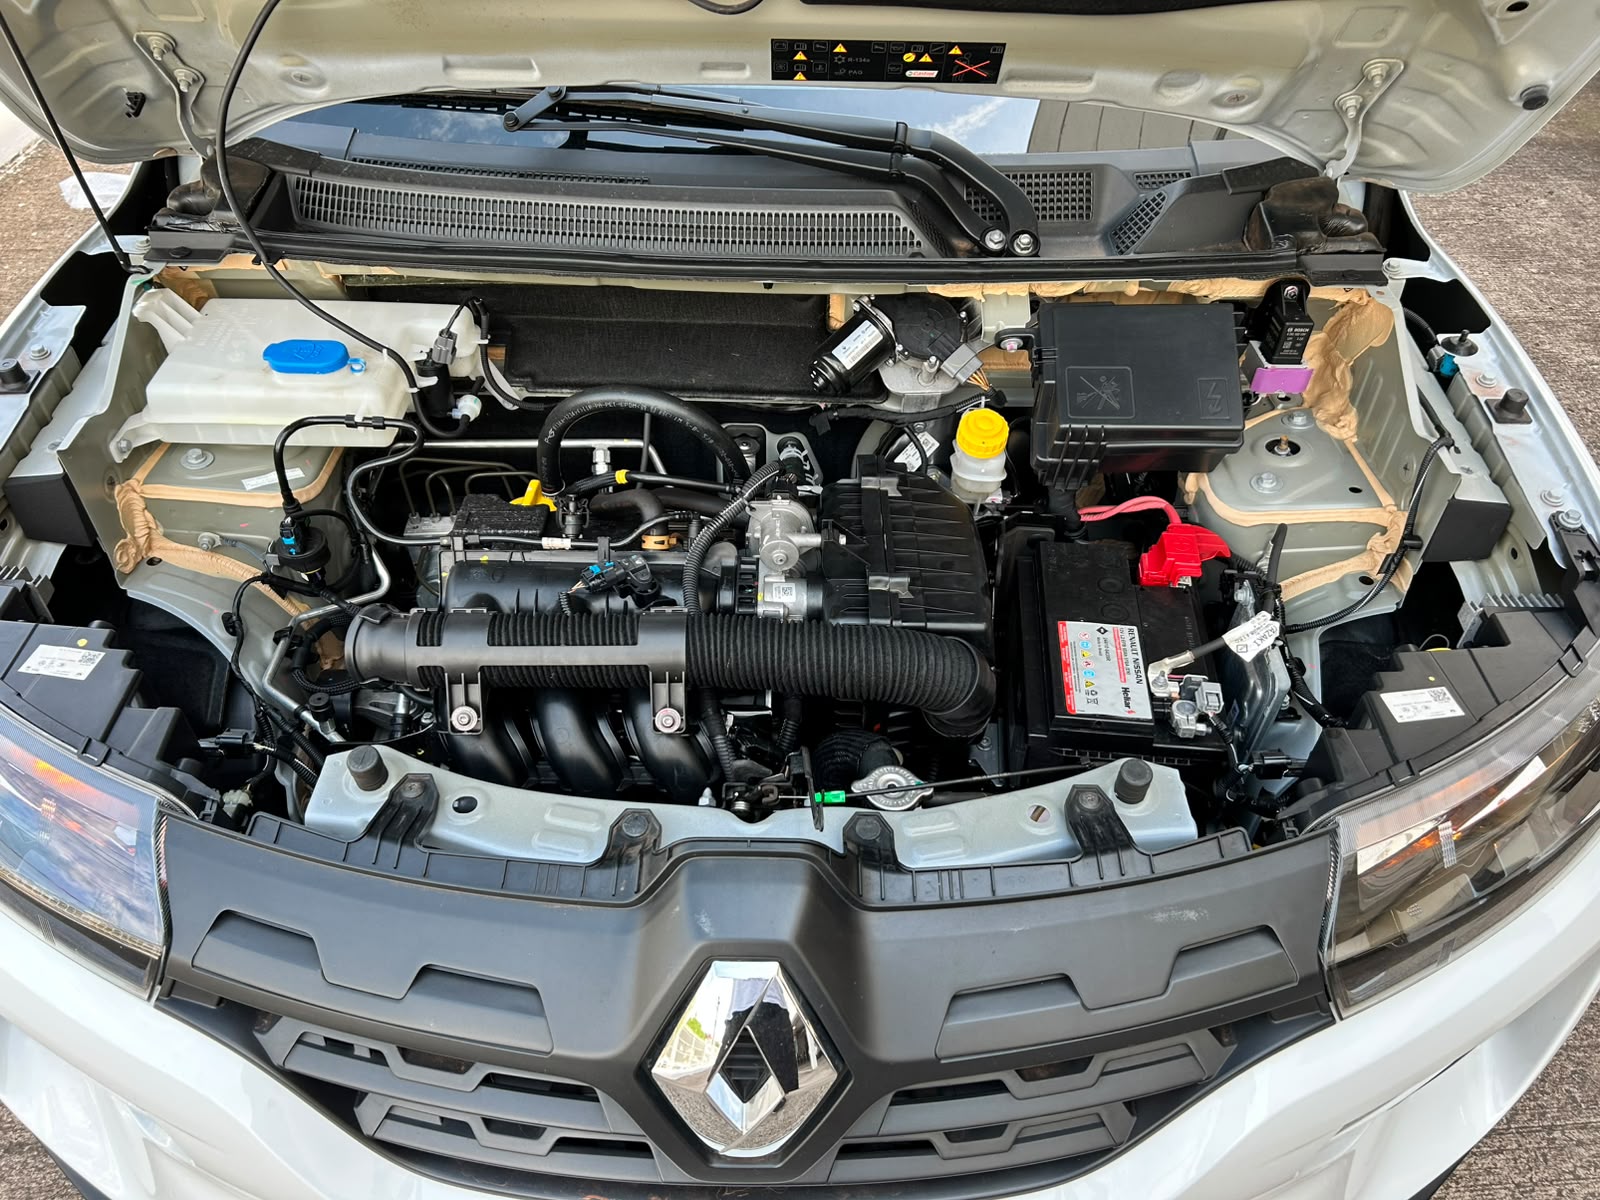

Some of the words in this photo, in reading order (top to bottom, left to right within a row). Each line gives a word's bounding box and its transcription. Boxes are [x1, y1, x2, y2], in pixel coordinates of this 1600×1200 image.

[1127, 628, 1139, 656] RENAULT
[1132, 657, 1143, 685] NISSAN
[1121, 686, 1131, 709] Heliar
